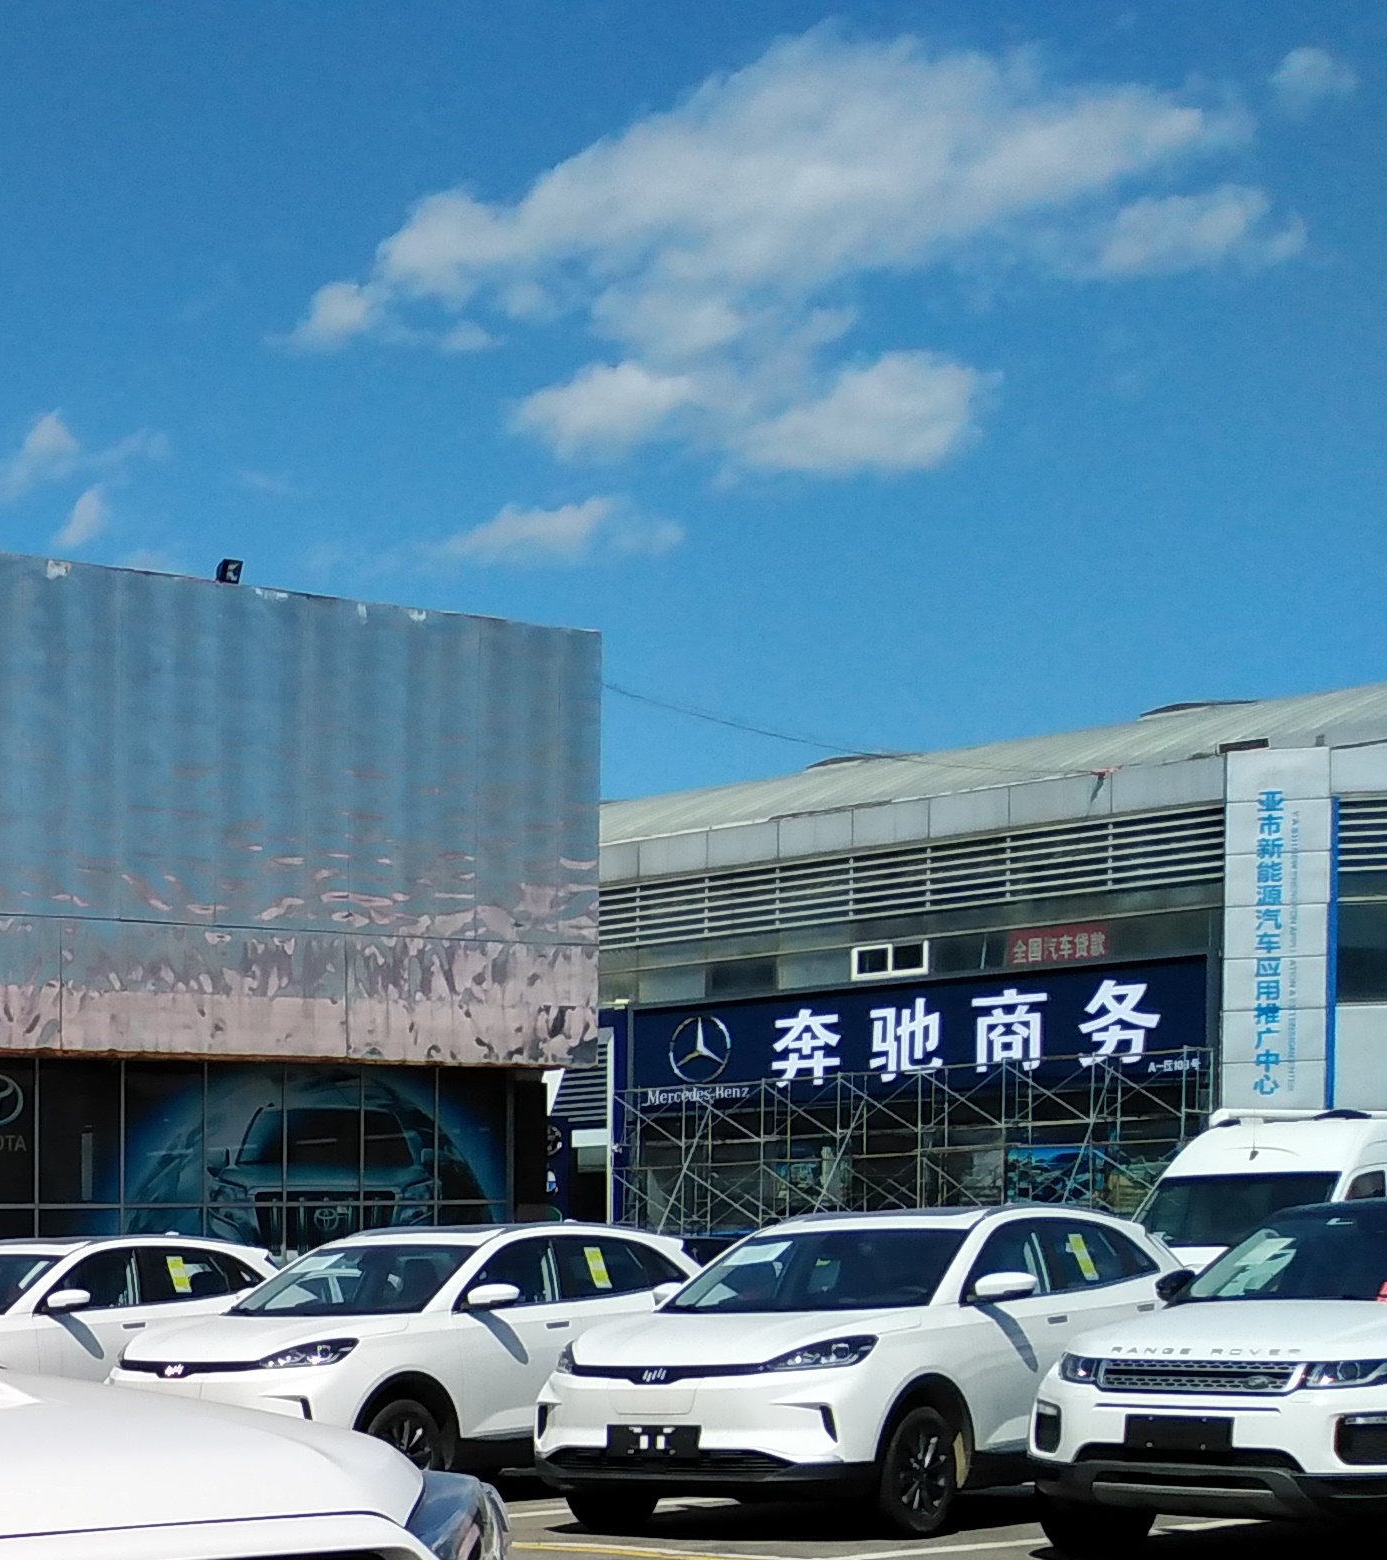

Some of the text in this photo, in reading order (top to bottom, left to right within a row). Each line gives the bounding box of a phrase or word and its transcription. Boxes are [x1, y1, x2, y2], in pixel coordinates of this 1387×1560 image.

[1013, 931, 1107, 964] 全国汽车贷款
[1253, 790, 1284, 1095] 亚市新能源汽车应用推广中心
[771, 978, 1161, 1088] 奔驰商务
[1111, 1346, 1302, 1356] RANGE ROVER
